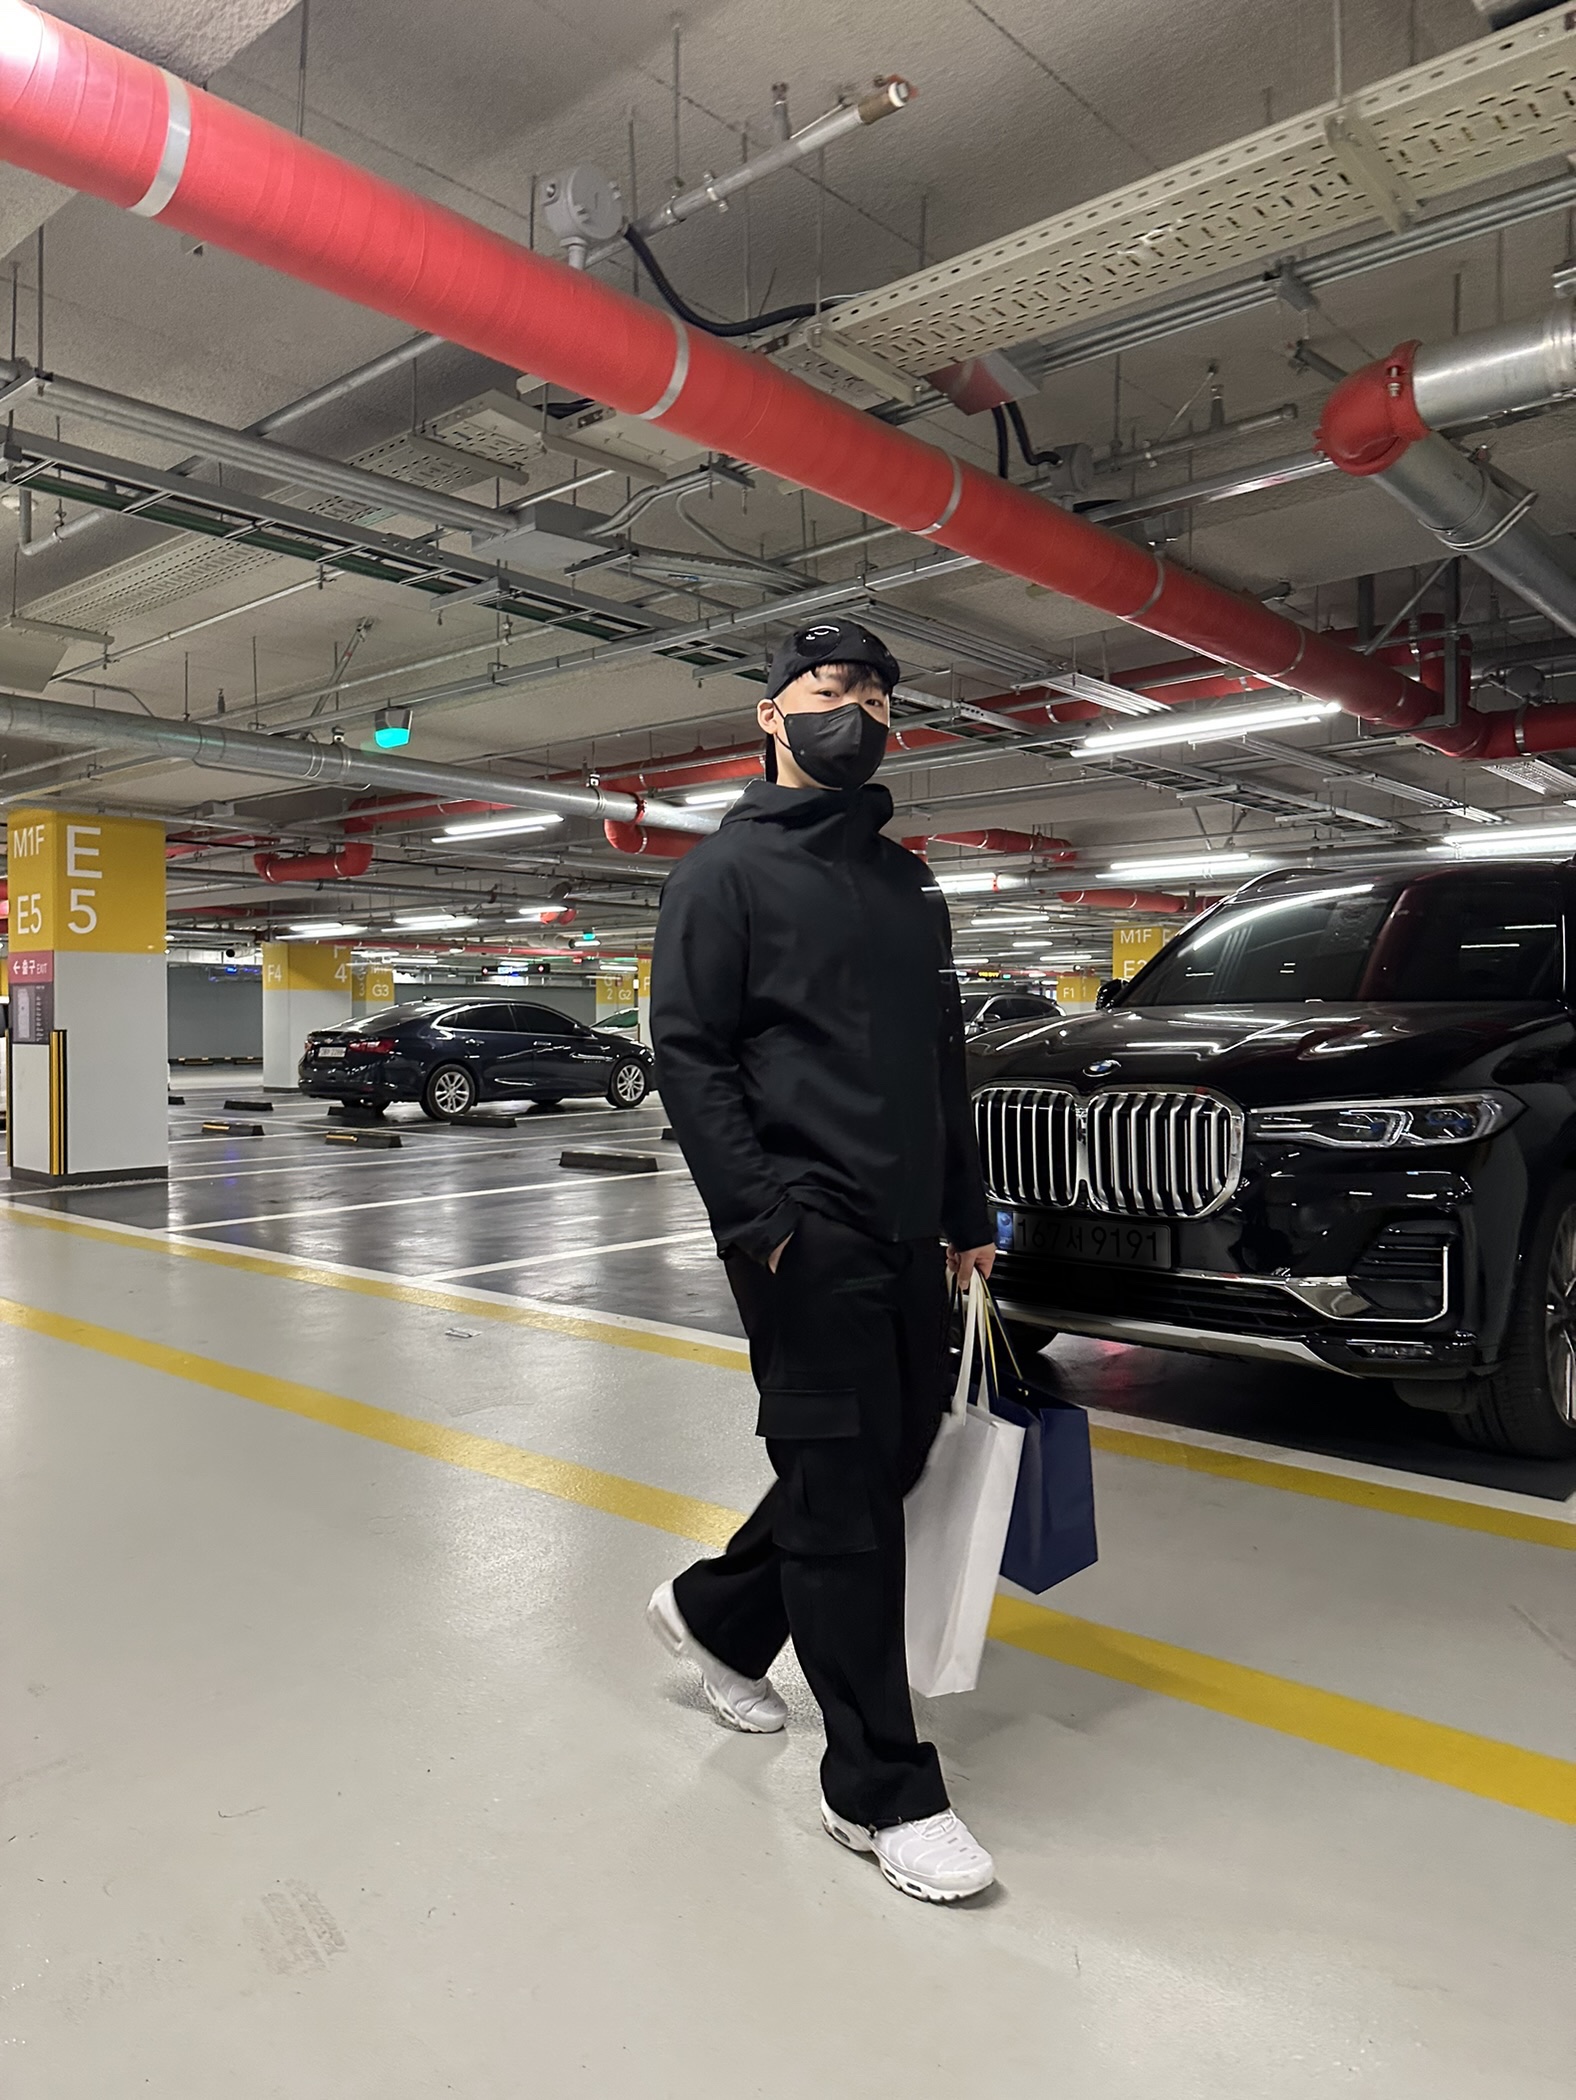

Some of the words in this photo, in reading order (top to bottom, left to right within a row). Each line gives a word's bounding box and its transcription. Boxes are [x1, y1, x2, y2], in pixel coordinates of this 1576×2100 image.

[14, 824, 45, 858] M1F
[67, 825, 103, 879] E
[17, 893, 42, 934] E5
[68, 889, 97, 934] 5
[1120, 929, 1152, 944] M1F
[267, 964, 282, 982] F4
[335, 963, 347, 983] 4
[372, 983, 390, 997] G3
[618, 989, 632, 1000] G2
[1063, 987, 1075, 998] F1
[1018, 1218, 1083, 1253] 167서
[1091, 1226, 1157, 1262] 9191
